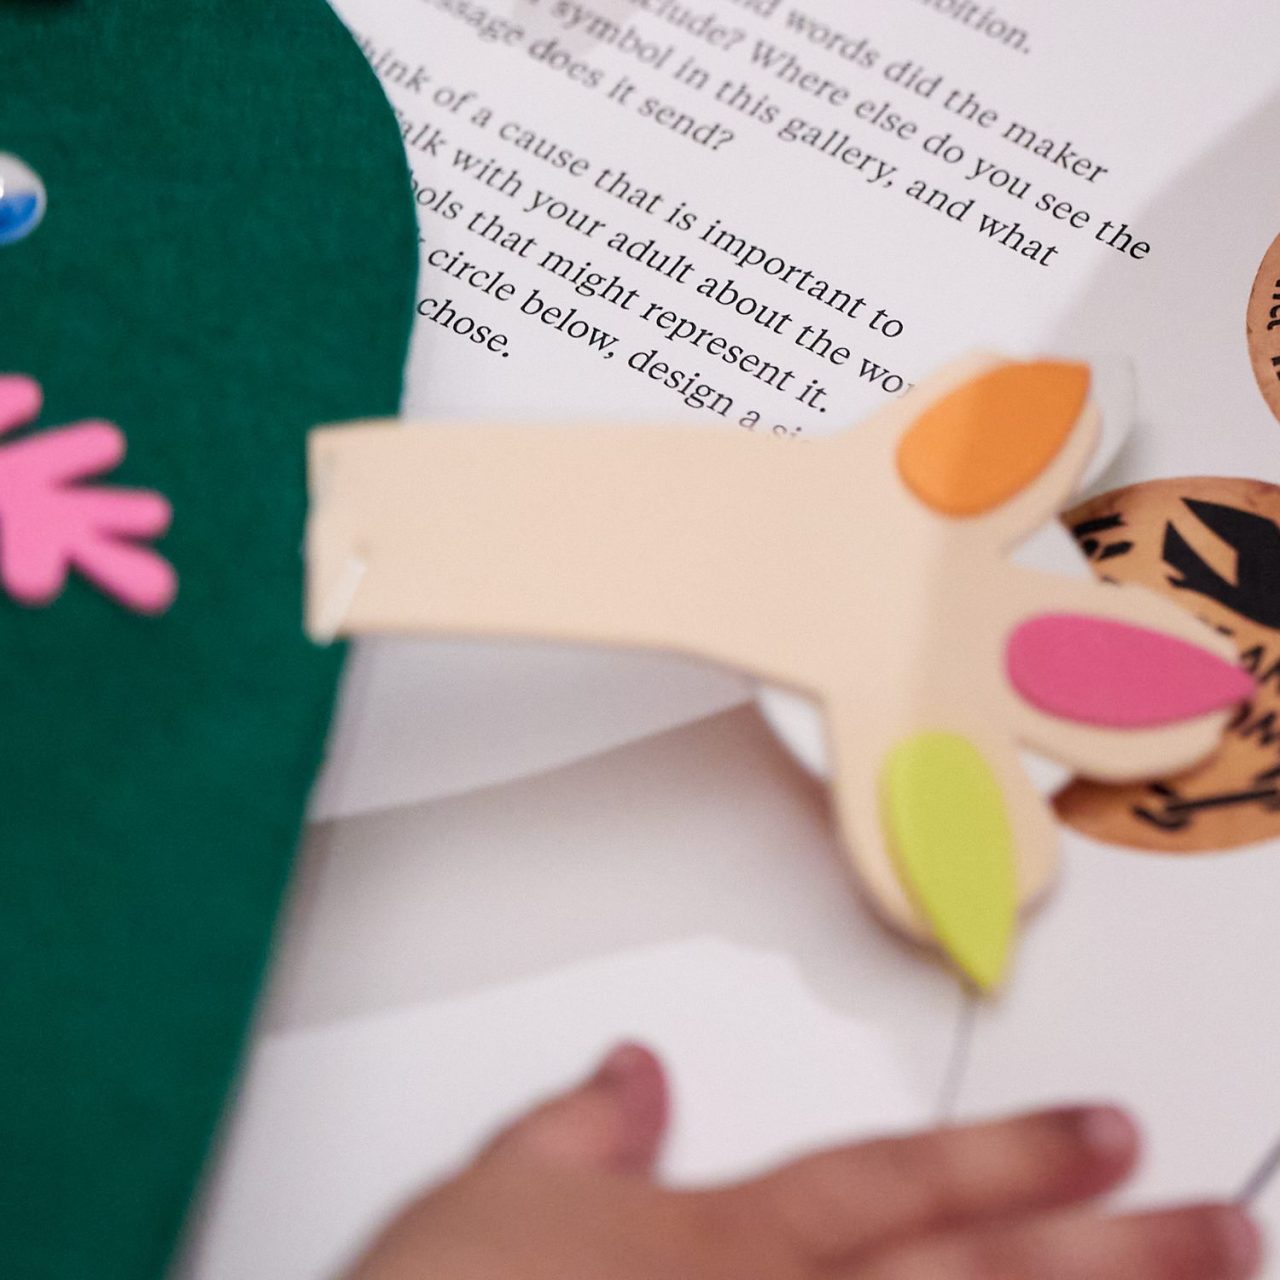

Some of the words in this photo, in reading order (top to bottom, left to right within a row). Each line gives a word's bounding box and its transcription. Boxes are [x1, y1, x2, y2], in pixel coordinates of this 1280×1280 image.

[356, 36, 430, 95] hink
[434, 83, 476, 116] of
[472, 111, 491, 129] a
[499, 122, 589, 177] cause
[594, 163, 664, 214] that
[667, 199, 697, 232] is
[699, 218, 871, 321] important
[873, 306, 905, 338] to
[528, 38, 604, 89] does
[608, 75, 638, 105] it
[637, 97, 735, 153] send?
[673, 58, 711, 91] in
[716, 80, 780, 125] this
[779, 116, 896, 189] gallery,
[906, 180, 975, 222] and
[977, 213, 1058, 267] what
[752, 40, 850, 107] Where
[855, 99, 917, 140] else
[923, 133, 963, 165] do
[966, 159, 1031, 200] you
[1036, 193, 1090, 230] see
[1096, 219, 1151, 261] the
[784, 8, 880, 69] words
[885, 60, 943, 99] did
[944, 90, 999, 129] the
[1002, 122, 1109, 185] maker
[400, 113, 446, 157] alk
[451, 148, 525, 200] with
[529, 187, 607, 238] your
[607, 226, 695, 286] adult
[697, 274, 792, 335] about
[795, 325, 851, 365] the
[417, 294, 510, 359] chose.
[428, 247, 516, 301] circle
[520, 291, 618, 360] below,
[629, 347, 735, 417] design
[739, 410, 760, 432] a
[467, 211, 538, 257] that
[541, 247, 640, 311] might
[640, 301, 797, 393] represent
[795, 381, 828, 413] it.
